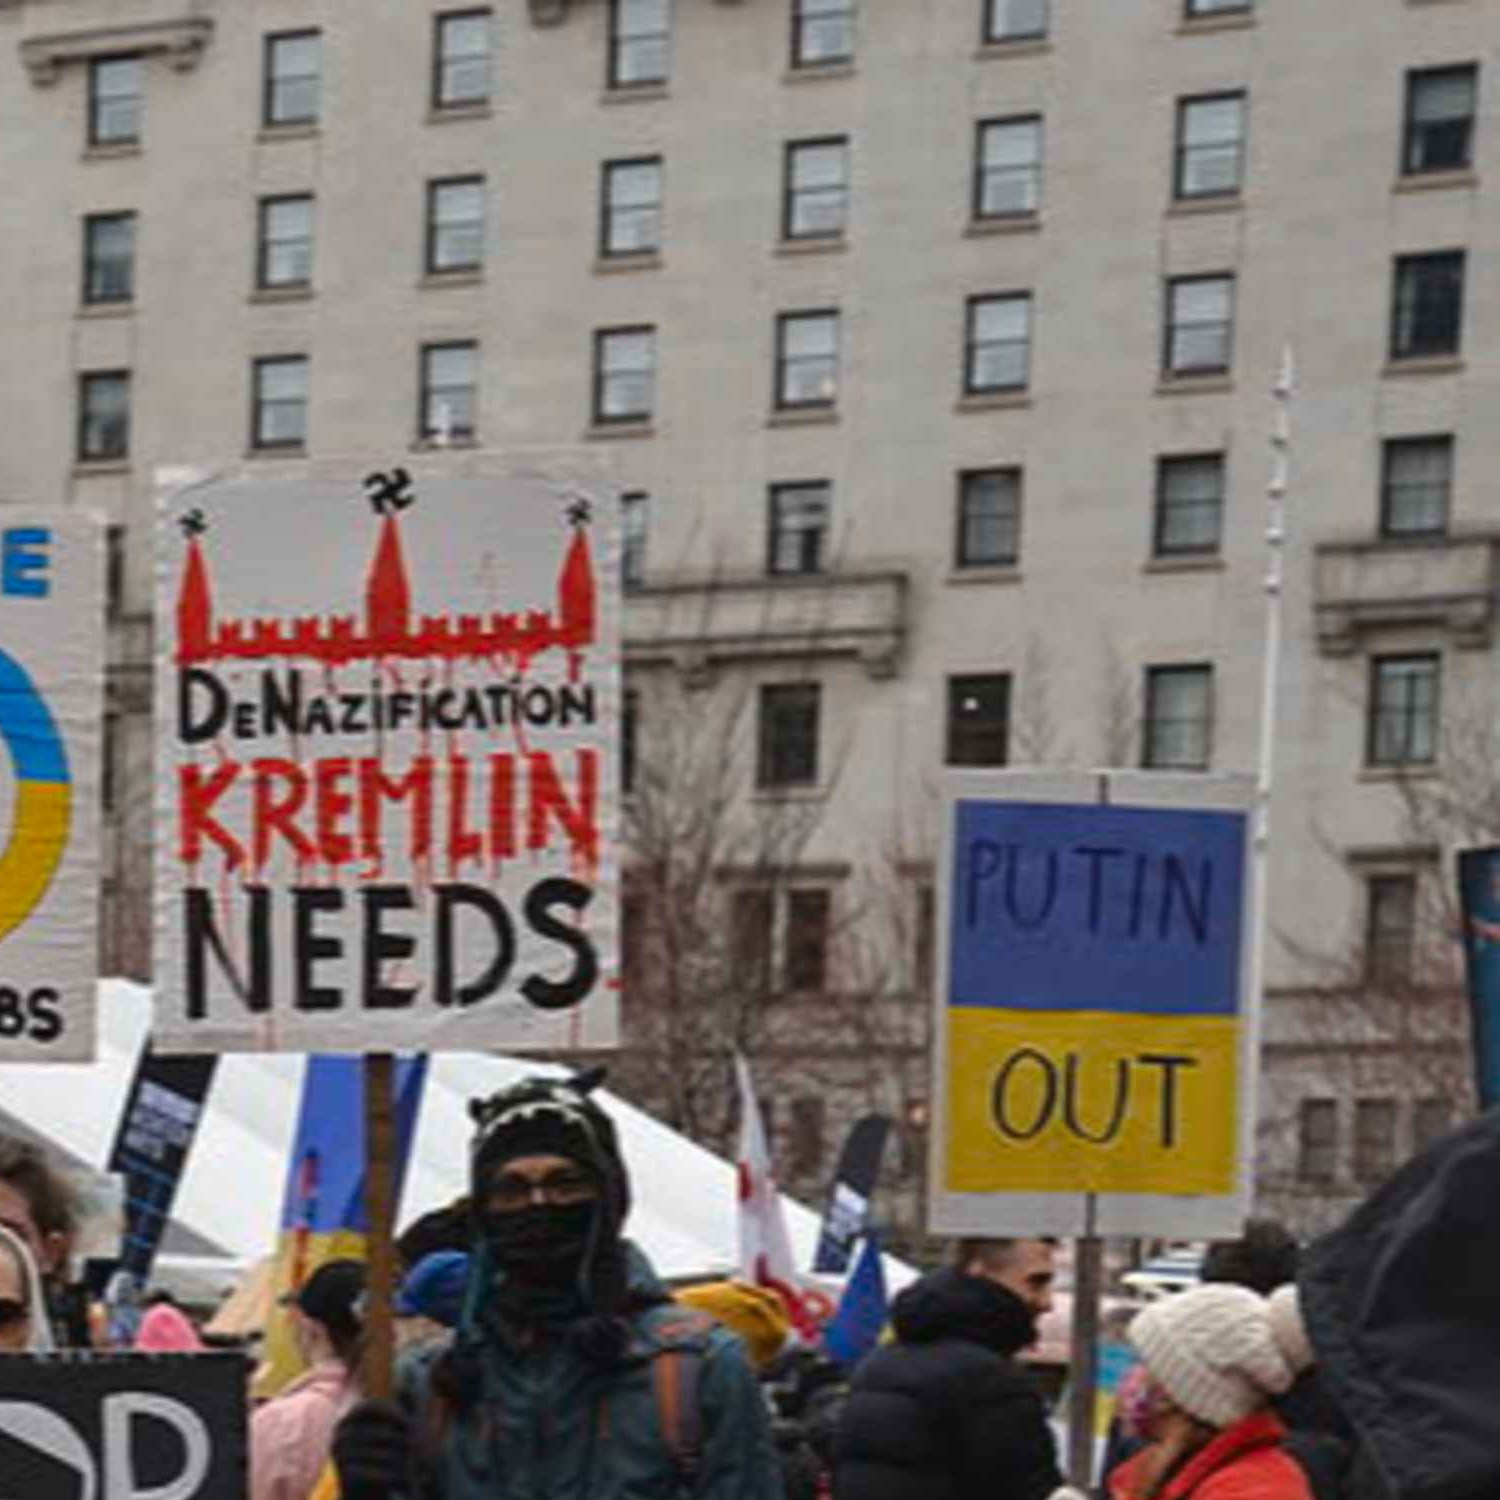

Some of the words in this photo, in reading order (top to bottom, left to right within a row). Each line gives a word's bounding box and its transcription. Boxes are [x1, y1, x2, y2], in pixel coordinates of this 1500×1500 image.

[177, 748, 599, 870] KREMLIN
[184, 877, 599, 1020] NEEDS
[966, 838, 1212, 945] PUTIN
[991, 1047, 1197, 1149] OUT
